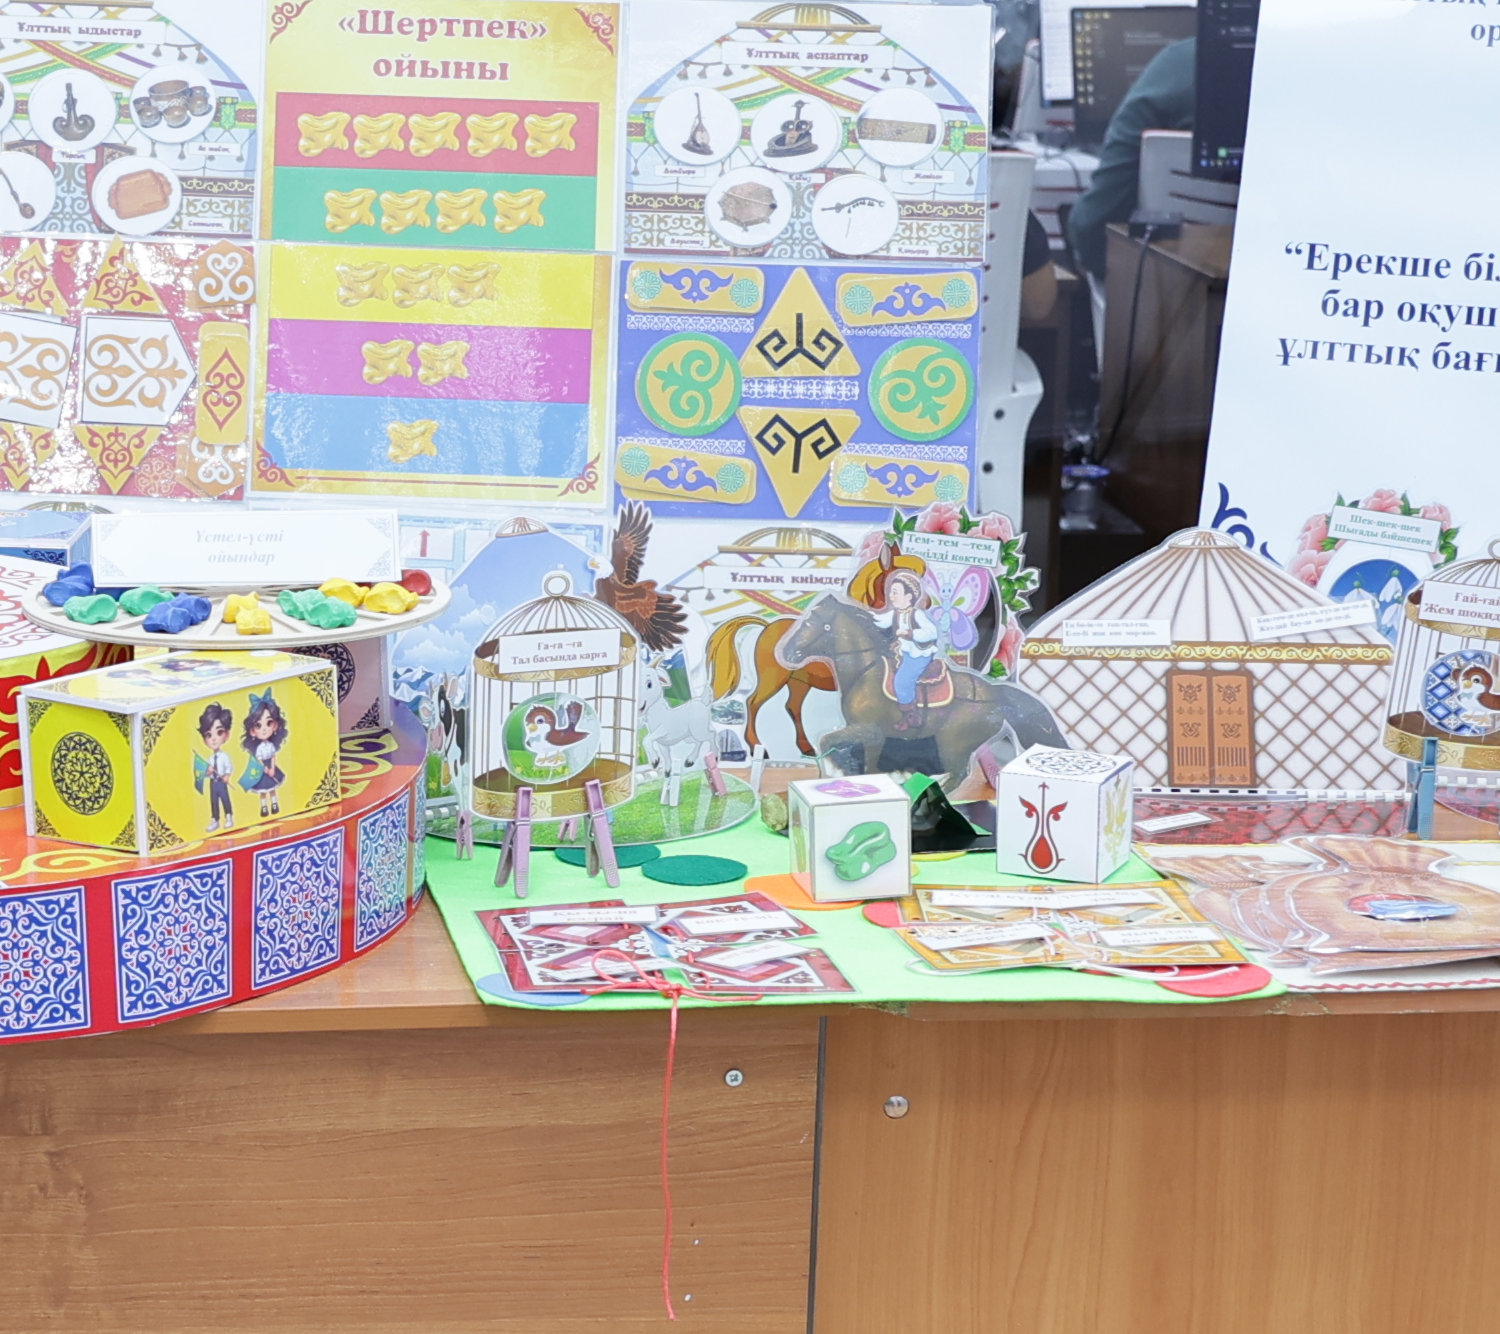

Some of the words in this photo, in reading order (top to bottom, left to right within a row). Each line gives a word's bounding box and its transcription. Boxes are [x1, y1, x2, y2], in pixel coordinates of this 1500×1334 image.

[17, 21, 72, 36] Ұлттық
[78, 25, 143, 39] ыдыстар
[338, 9, 548, 42] «Шертпек»
[746, 47, 801, 61] Ұлттық
[806, 49, 869, 64] аспаптар
[373, 52, 510, 81] ойыны
[1283, 241, 1453, 280] “Ерекше
[1320, 287, 1386, 328] бар
[1275, 333, 1420, 369] ұлттық
[1333, 524, 1379, 540] Шығады
[1349, 514, 1422, 533] Шек-шек-шек
[194, 528, 284, 546] Үстел-үсті
[907, 533, 935, 546] Тем-
[937, 537, 959, 548] тем
[207, 549, 276, 567] ойындар
[730, 571, 784, 584] Ұлттық
[1423, 602, 1455, 616] Жем
[511, 655, 531, 665] Тал
[532, 652, 578, 664] басында
